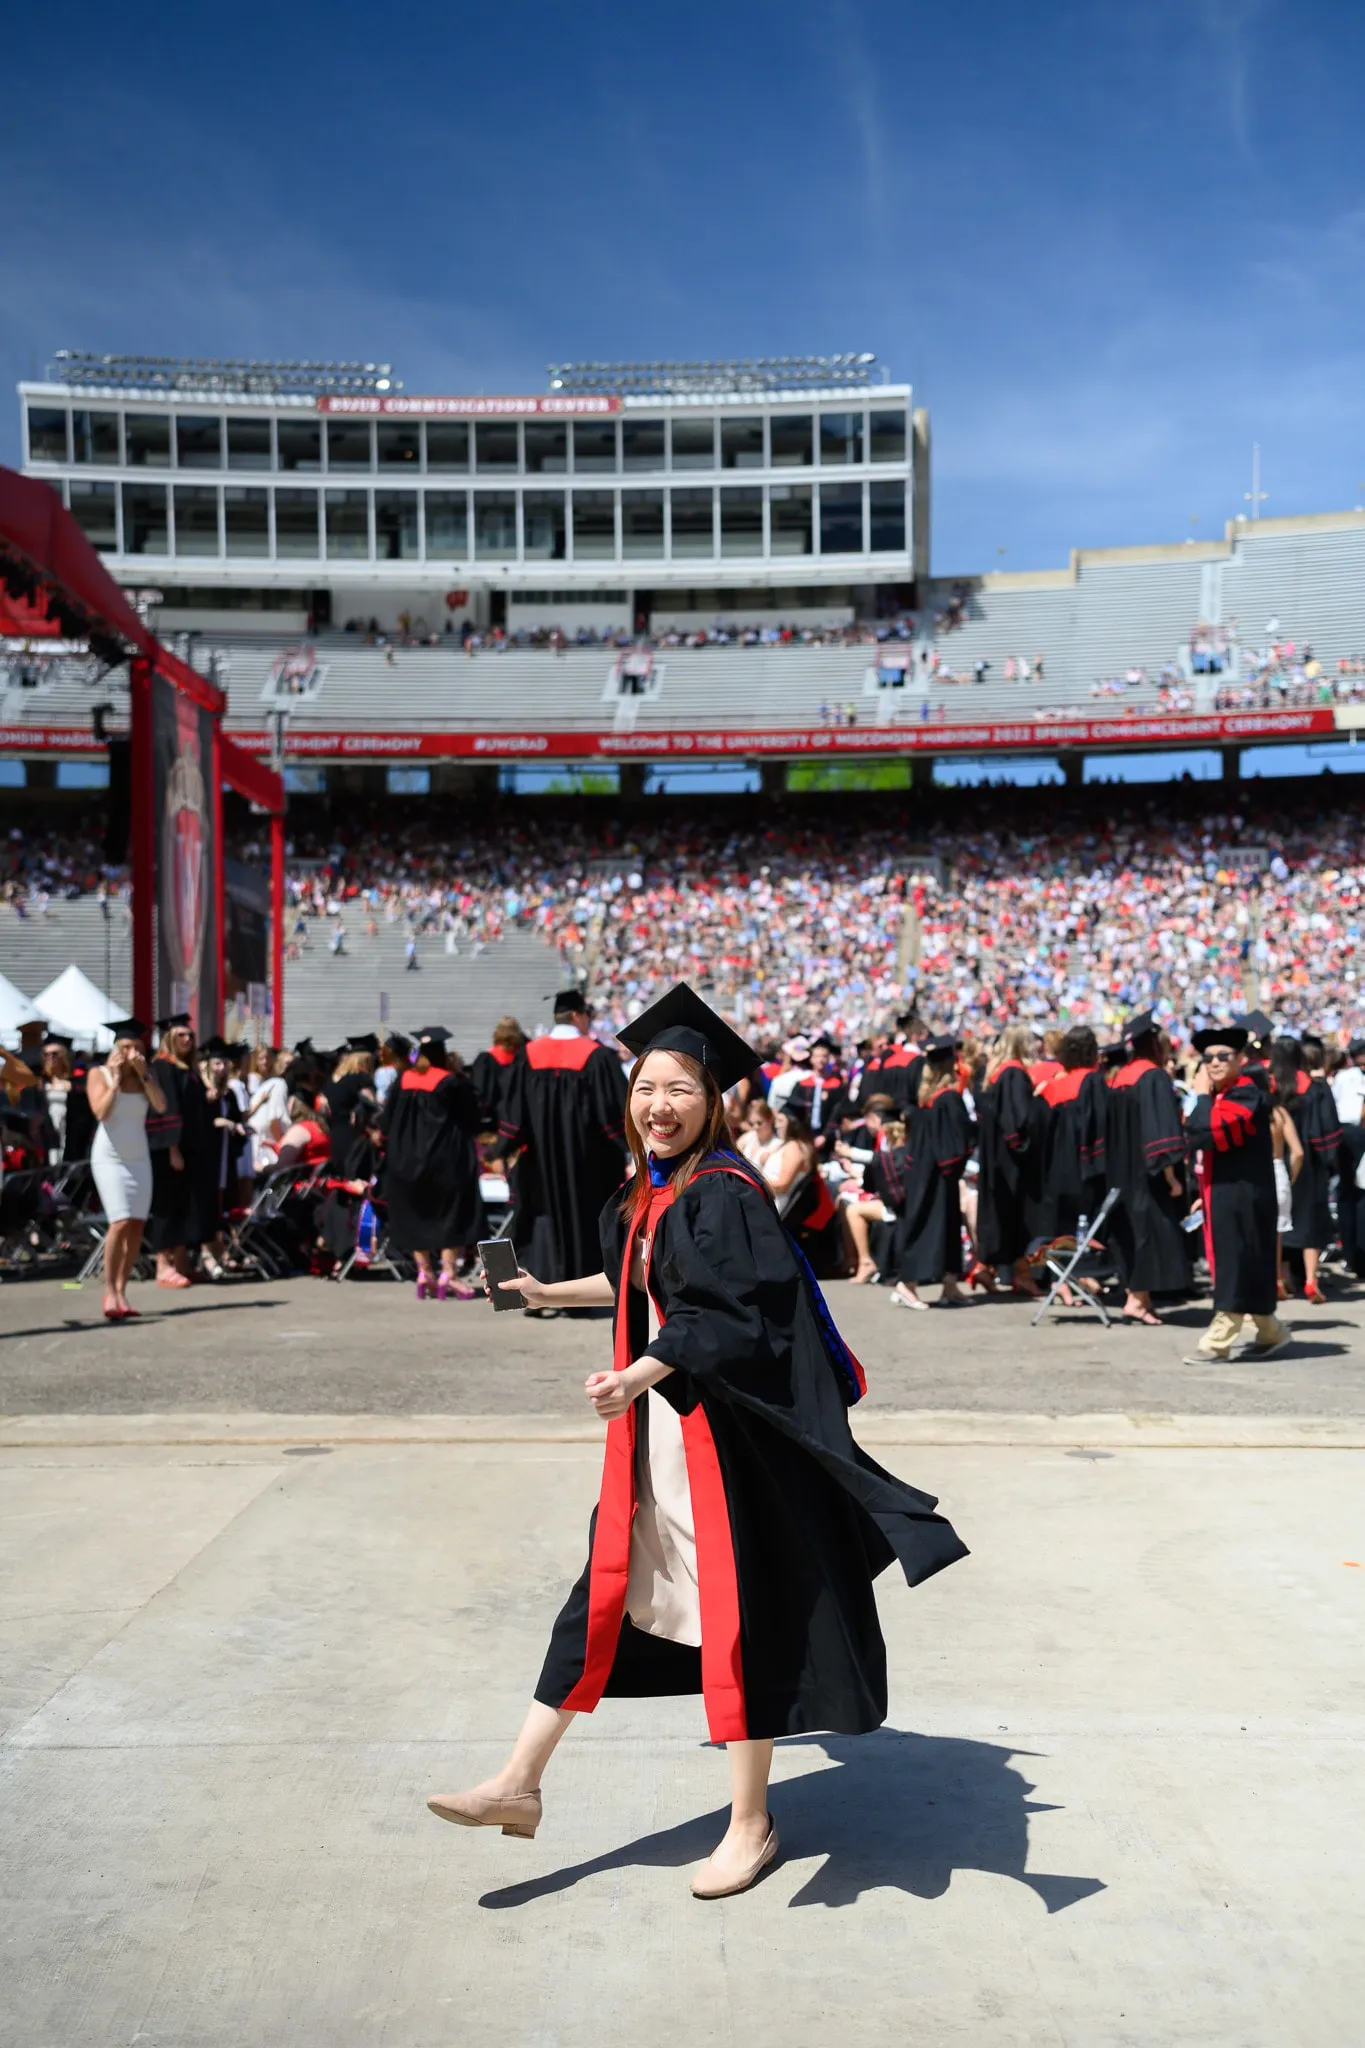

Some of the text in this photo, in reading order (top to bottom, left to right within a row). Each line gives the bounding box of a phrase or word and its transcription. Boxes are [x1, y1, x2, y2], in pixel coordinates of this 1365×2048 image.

[384, 398, 537, 412] COMMUNICATIONS
[541, 397, 610, 412] CENTER
[599, 735, 669, 750] WELCOME
[672, 735, 693, 749] TO
[696, 734, 722, 749] THE
[726, 733, 809, 748] UNIVERSITY
[810, 733, 832, 747] OF
[1091, 718, 1221, 738] COMMENCEMENT
[1224, 714, 1313, 733] CEREMONY
[343, 735, 423, 751] CEREMONY
